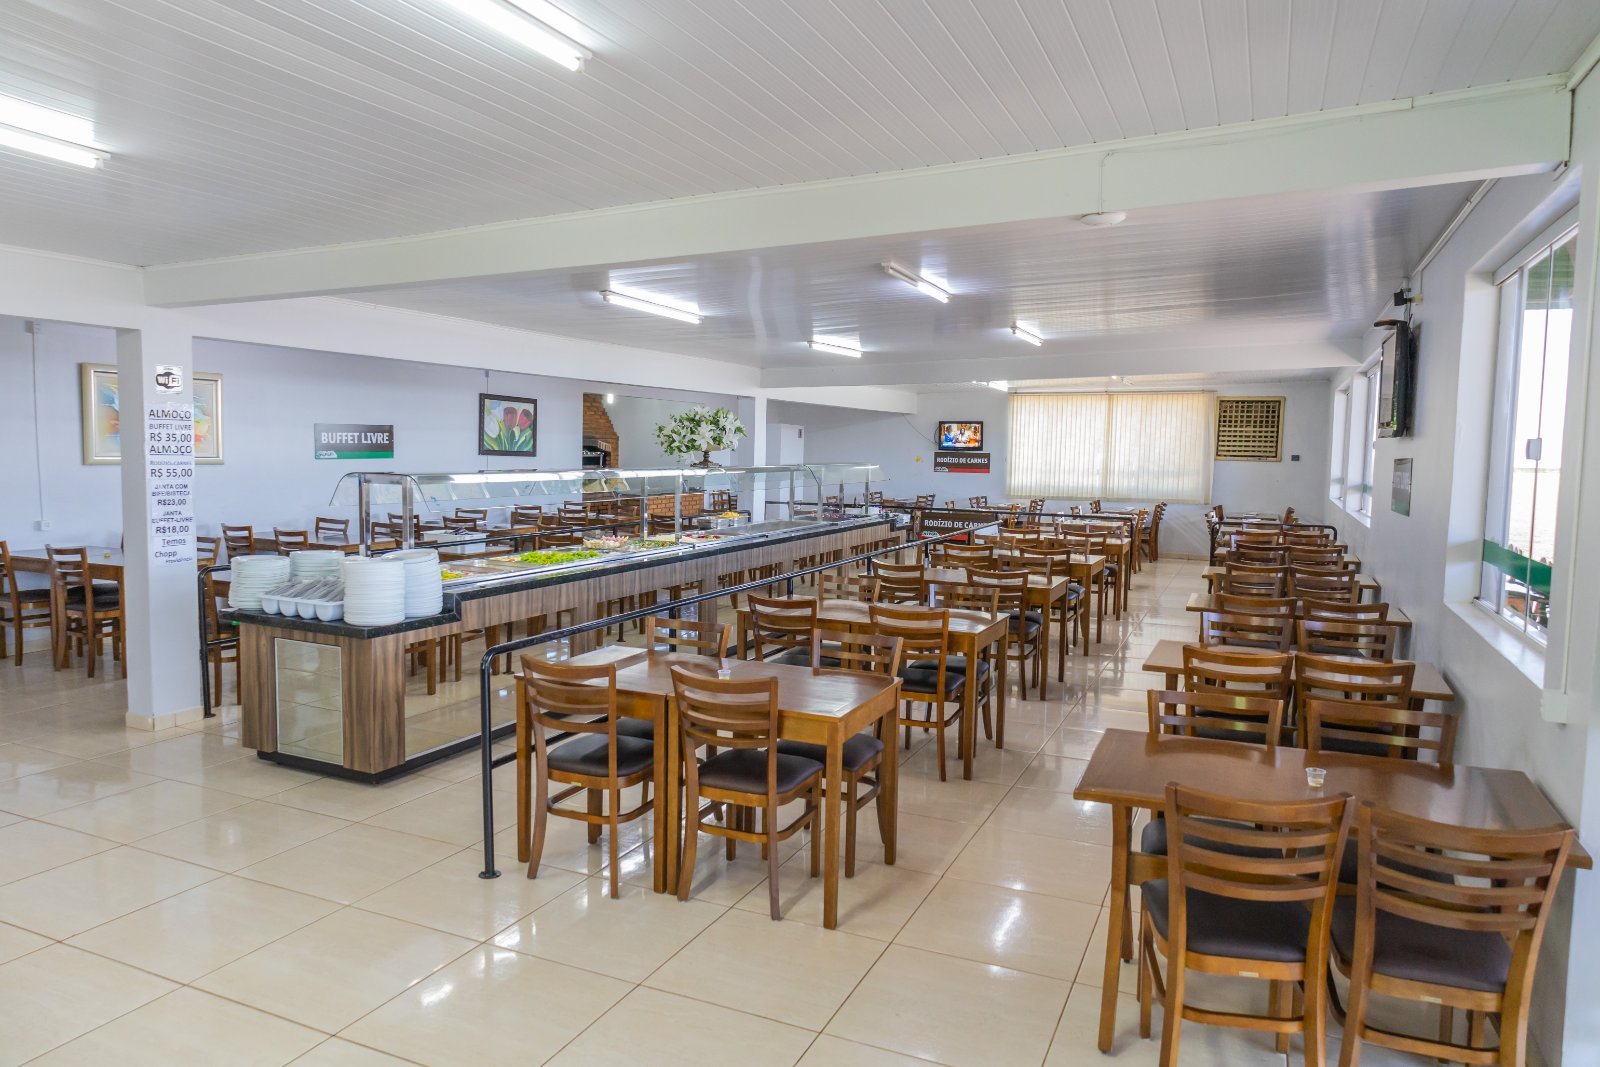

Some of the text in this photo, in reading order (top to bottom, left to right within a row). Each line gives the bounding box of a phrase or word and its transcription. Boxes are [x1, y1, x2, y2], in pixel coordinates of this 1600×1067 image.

[149, 409, 191, 419] ALMOÇO
[150, 432, 192, 443] R$ 35,00
[321, 432, 389, 444] BUFFET LIVRE
[150, 445, 192, 455] ALMOÇO
[151, 468, 192, 478] R$ 55,00
[924, 519, 953, 528] RODÍZIO
[954, 521, 963, 529] DE
[156, 525, 189, 534] R$18,00
[162, 538, 186, 547] Temos
[155, 551, 177, 559] Chopp
